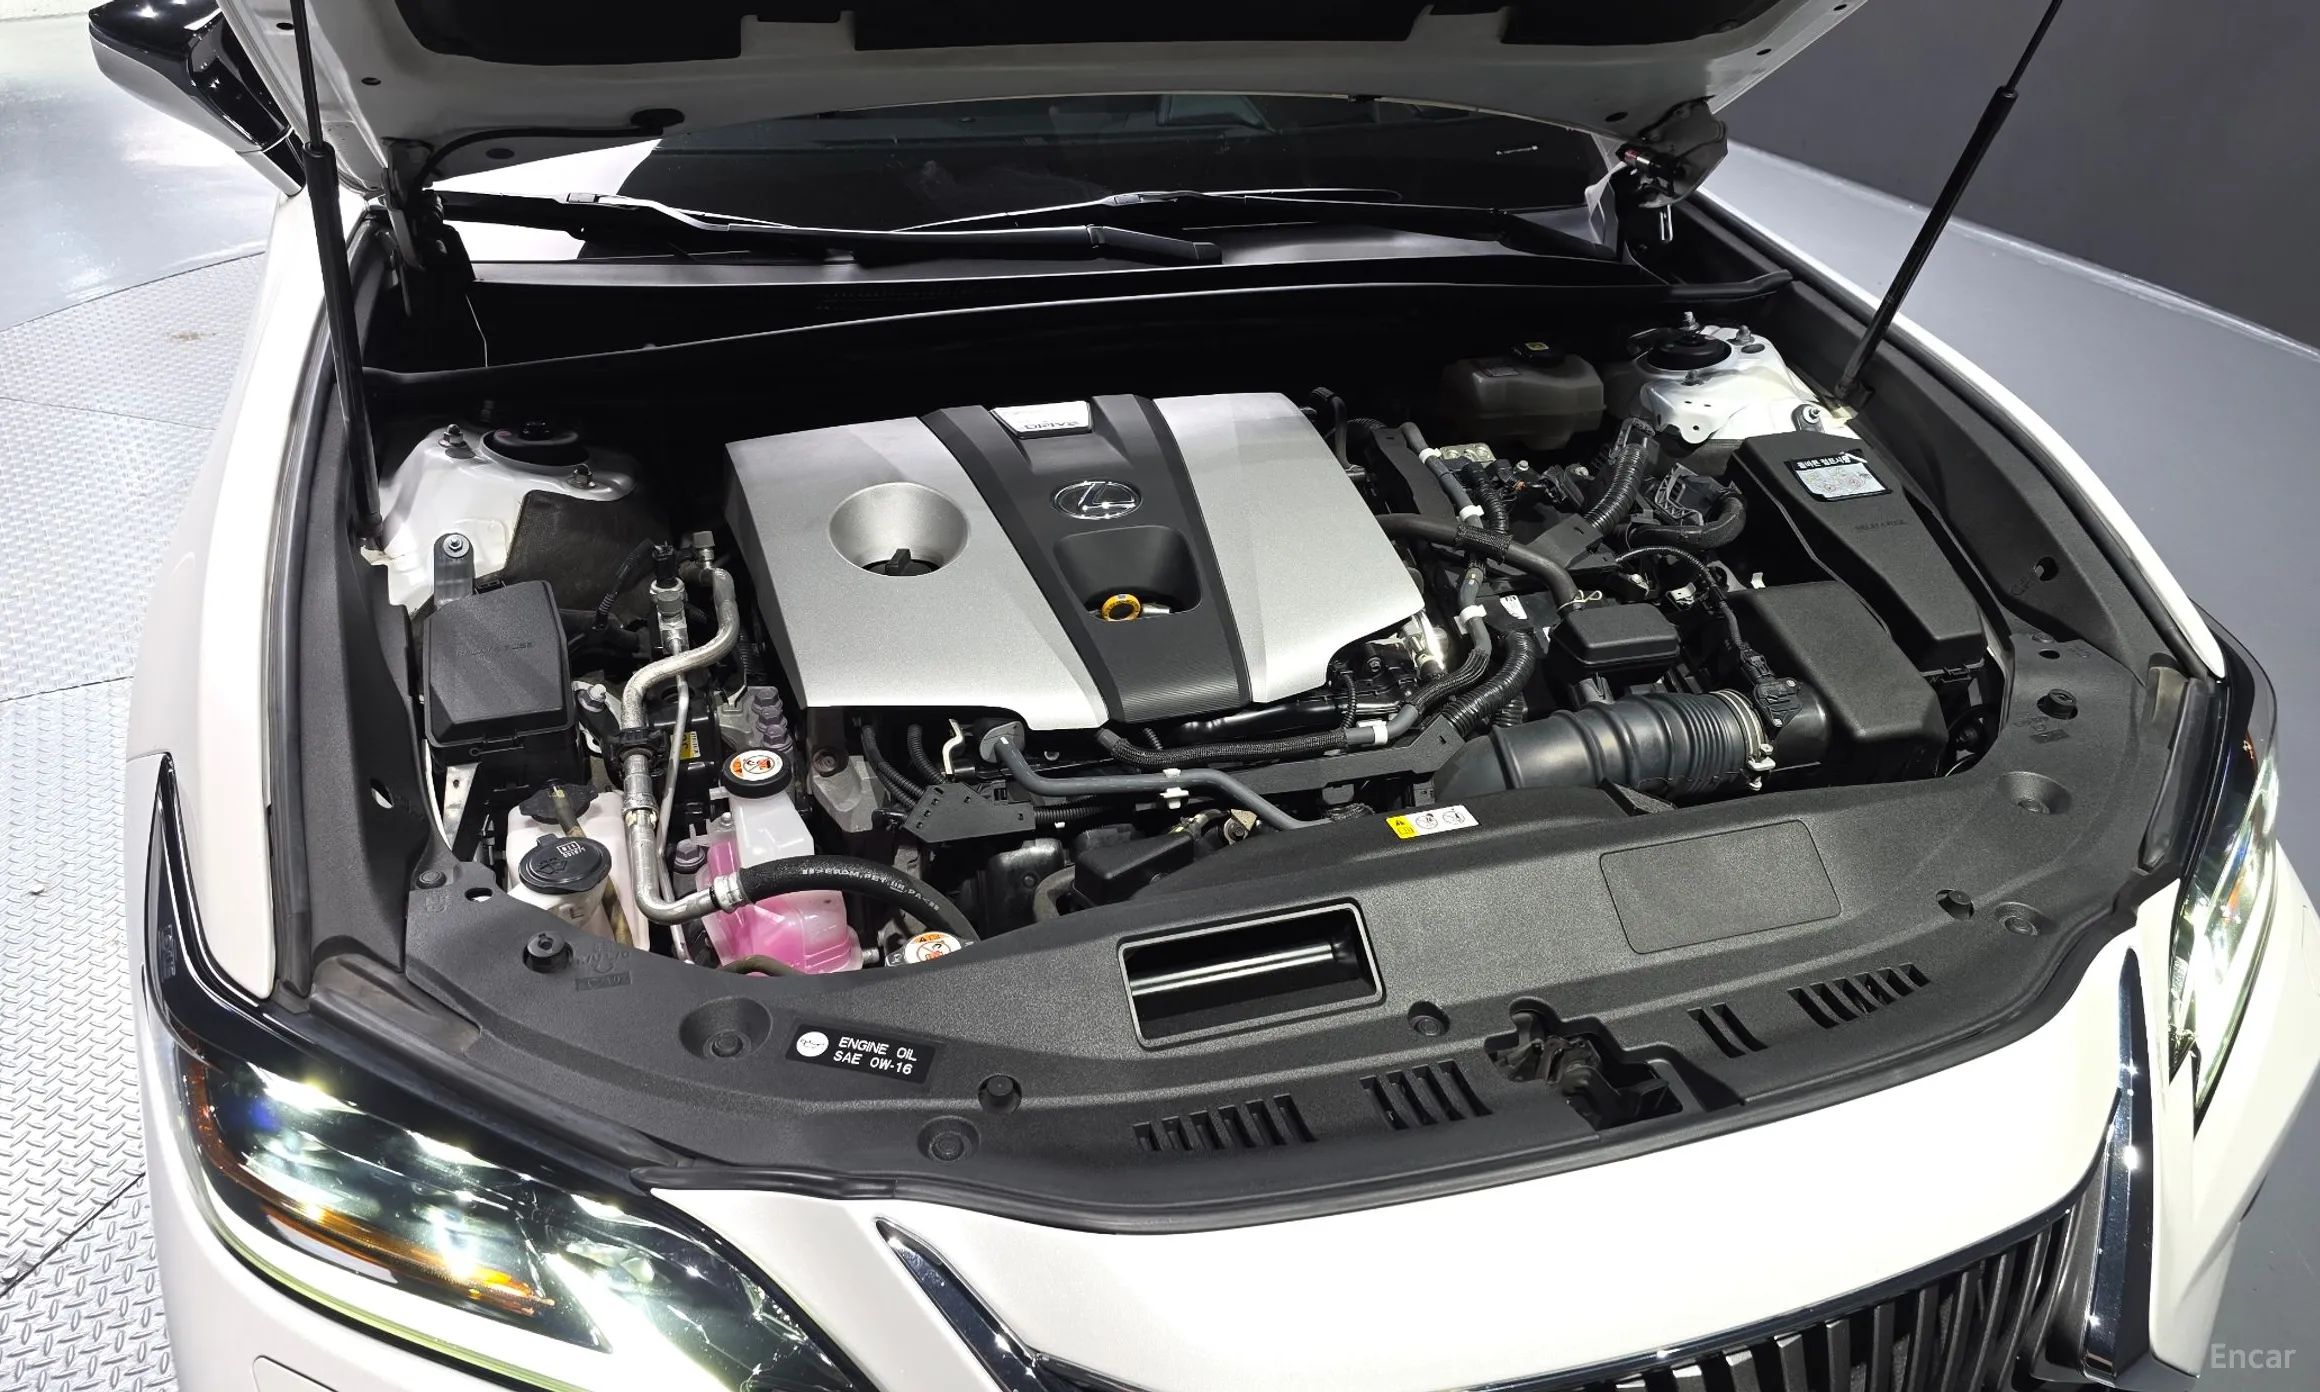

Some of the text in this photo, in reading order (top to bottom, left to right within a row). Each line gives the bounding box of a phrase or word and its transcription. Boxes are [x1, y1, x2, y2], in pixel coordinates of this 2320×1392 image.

[838, 1036, 918, 1062] ENGINE OIL
[833, 1050, 913, 1075] SAE 0W-16
